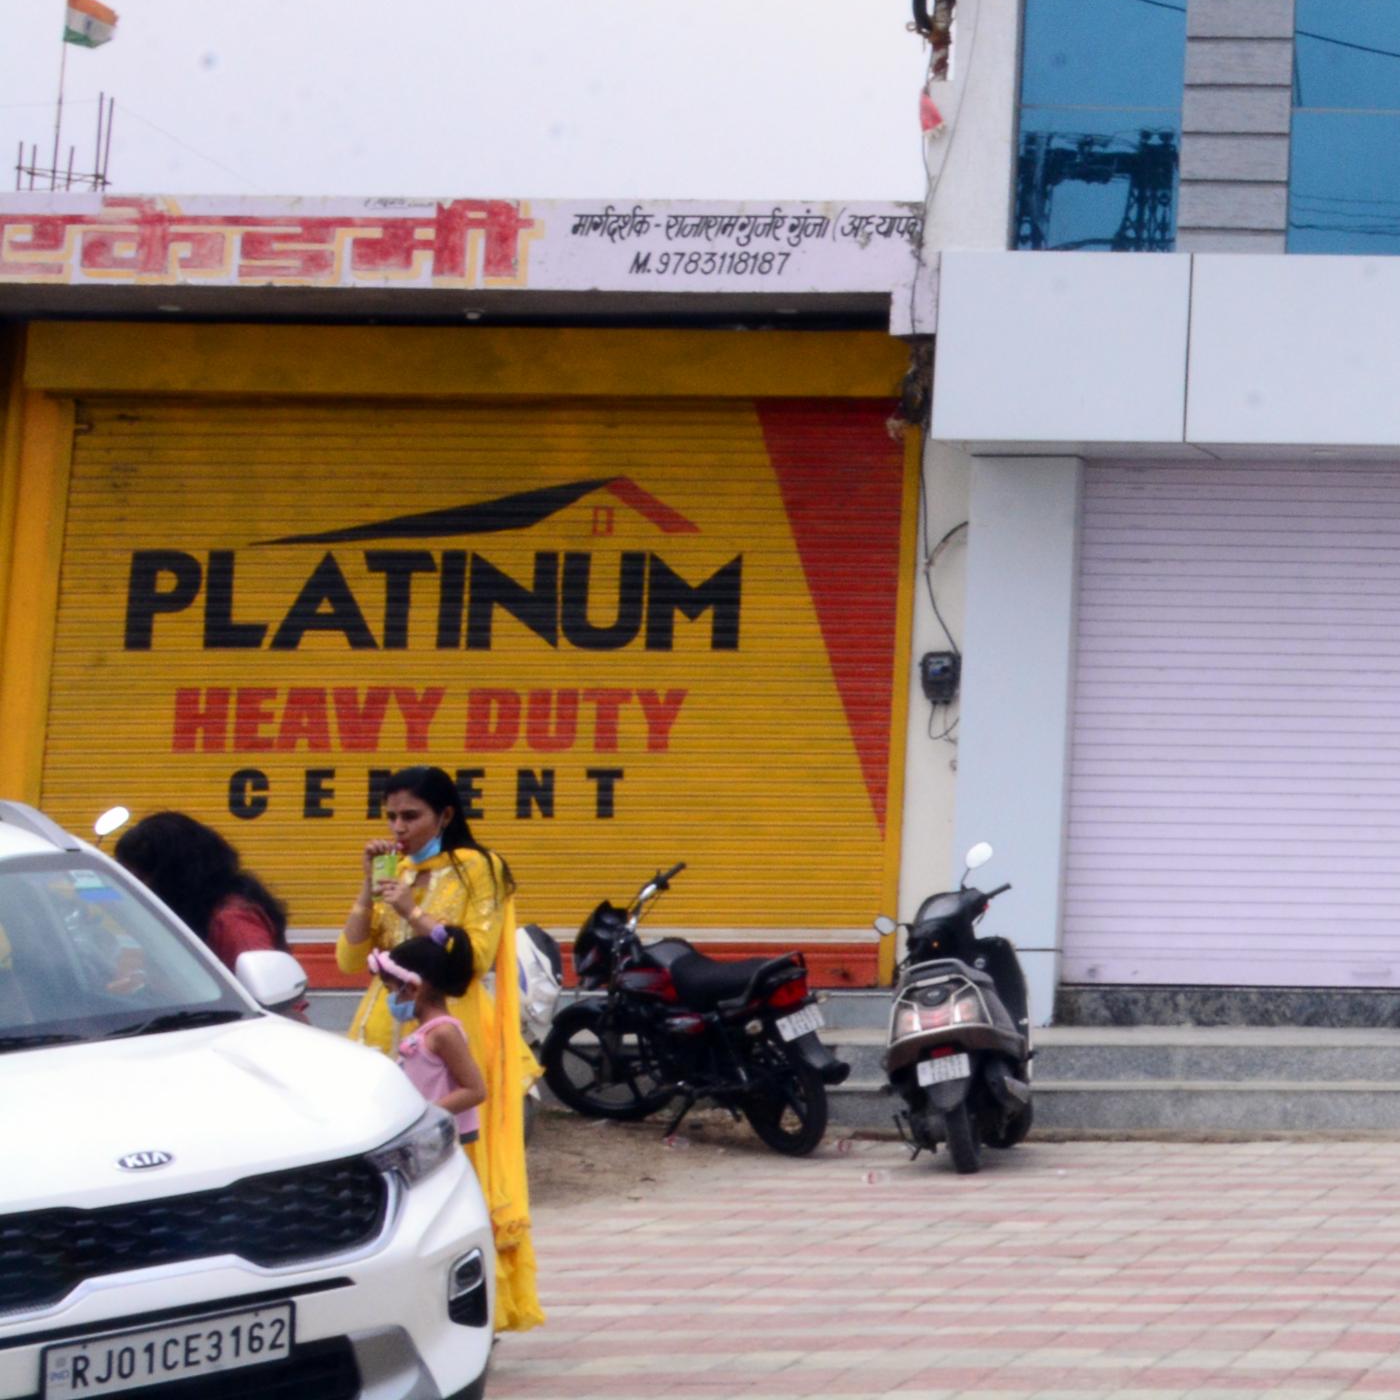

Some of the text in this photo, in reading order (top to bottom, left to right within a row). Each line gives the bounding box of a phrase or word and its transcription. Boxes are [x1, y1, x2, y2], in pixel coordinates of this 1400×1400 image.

[572, 205, 654, 242] मार्गदर्शक
[123, 549, 743, 652] PLATINUM
[171, 687, 690, 754] HEAVY DUTY
[122, 1151, 170, 1168] KIA
[71, 1318, 287, 1389] RJ01CE3162
